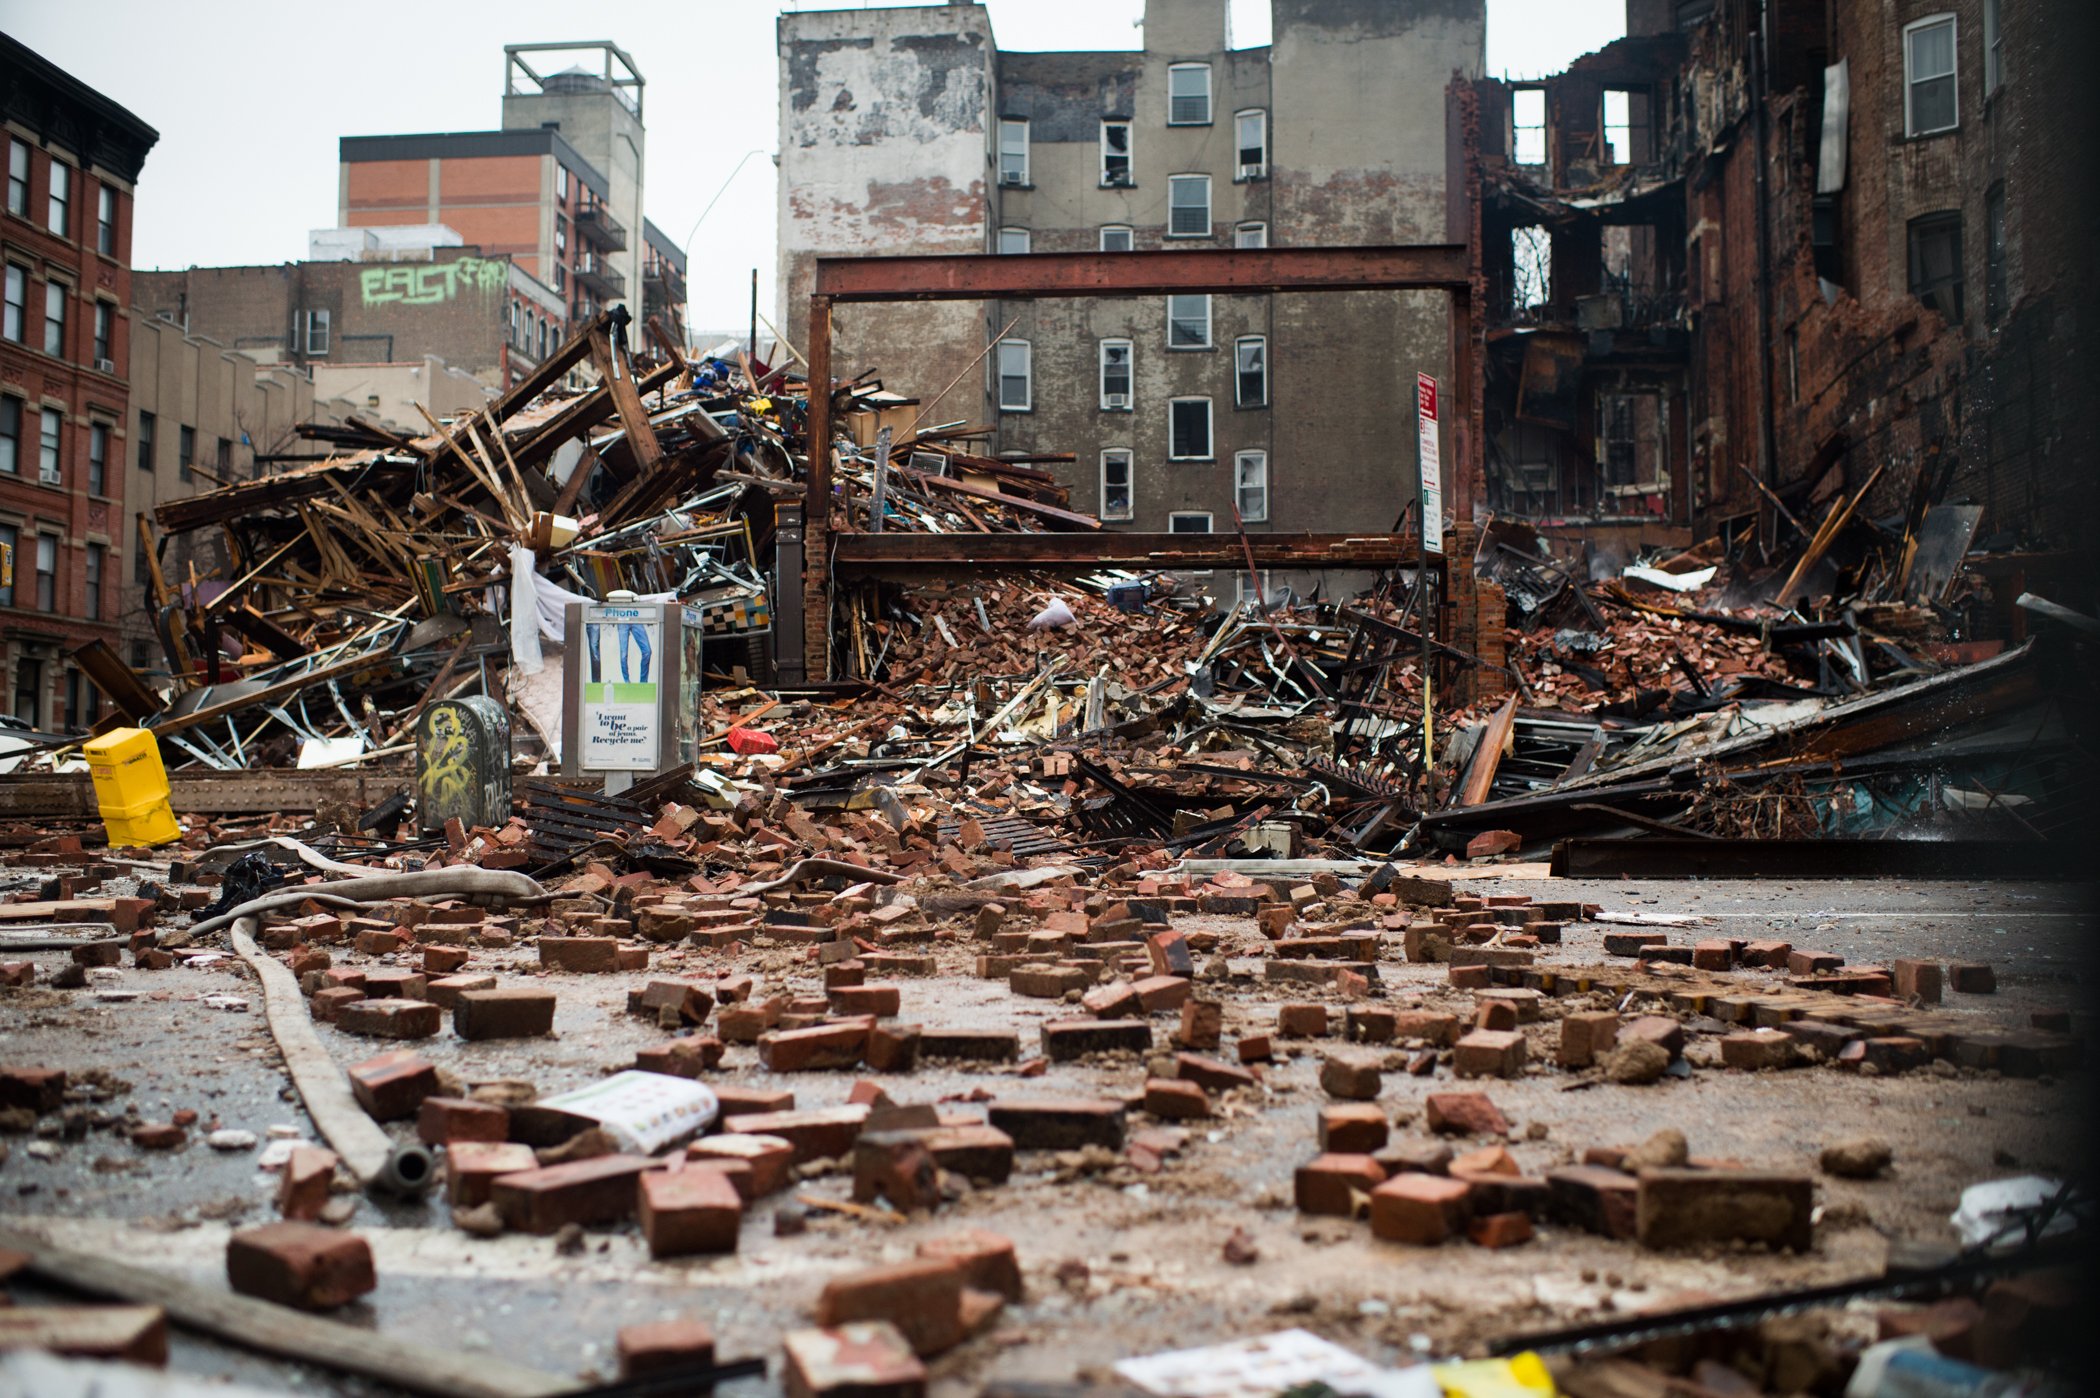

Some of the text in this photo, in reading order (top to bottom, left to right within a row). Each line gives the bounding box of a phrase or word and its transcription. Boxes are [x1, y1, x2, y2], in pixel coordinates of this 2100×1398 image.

[360, 263, 460, 305] EAST
[604, 608, 639, 617] Phone
[610, 719, 627, 731] be
[592, 736, 629, 745] Recycle
